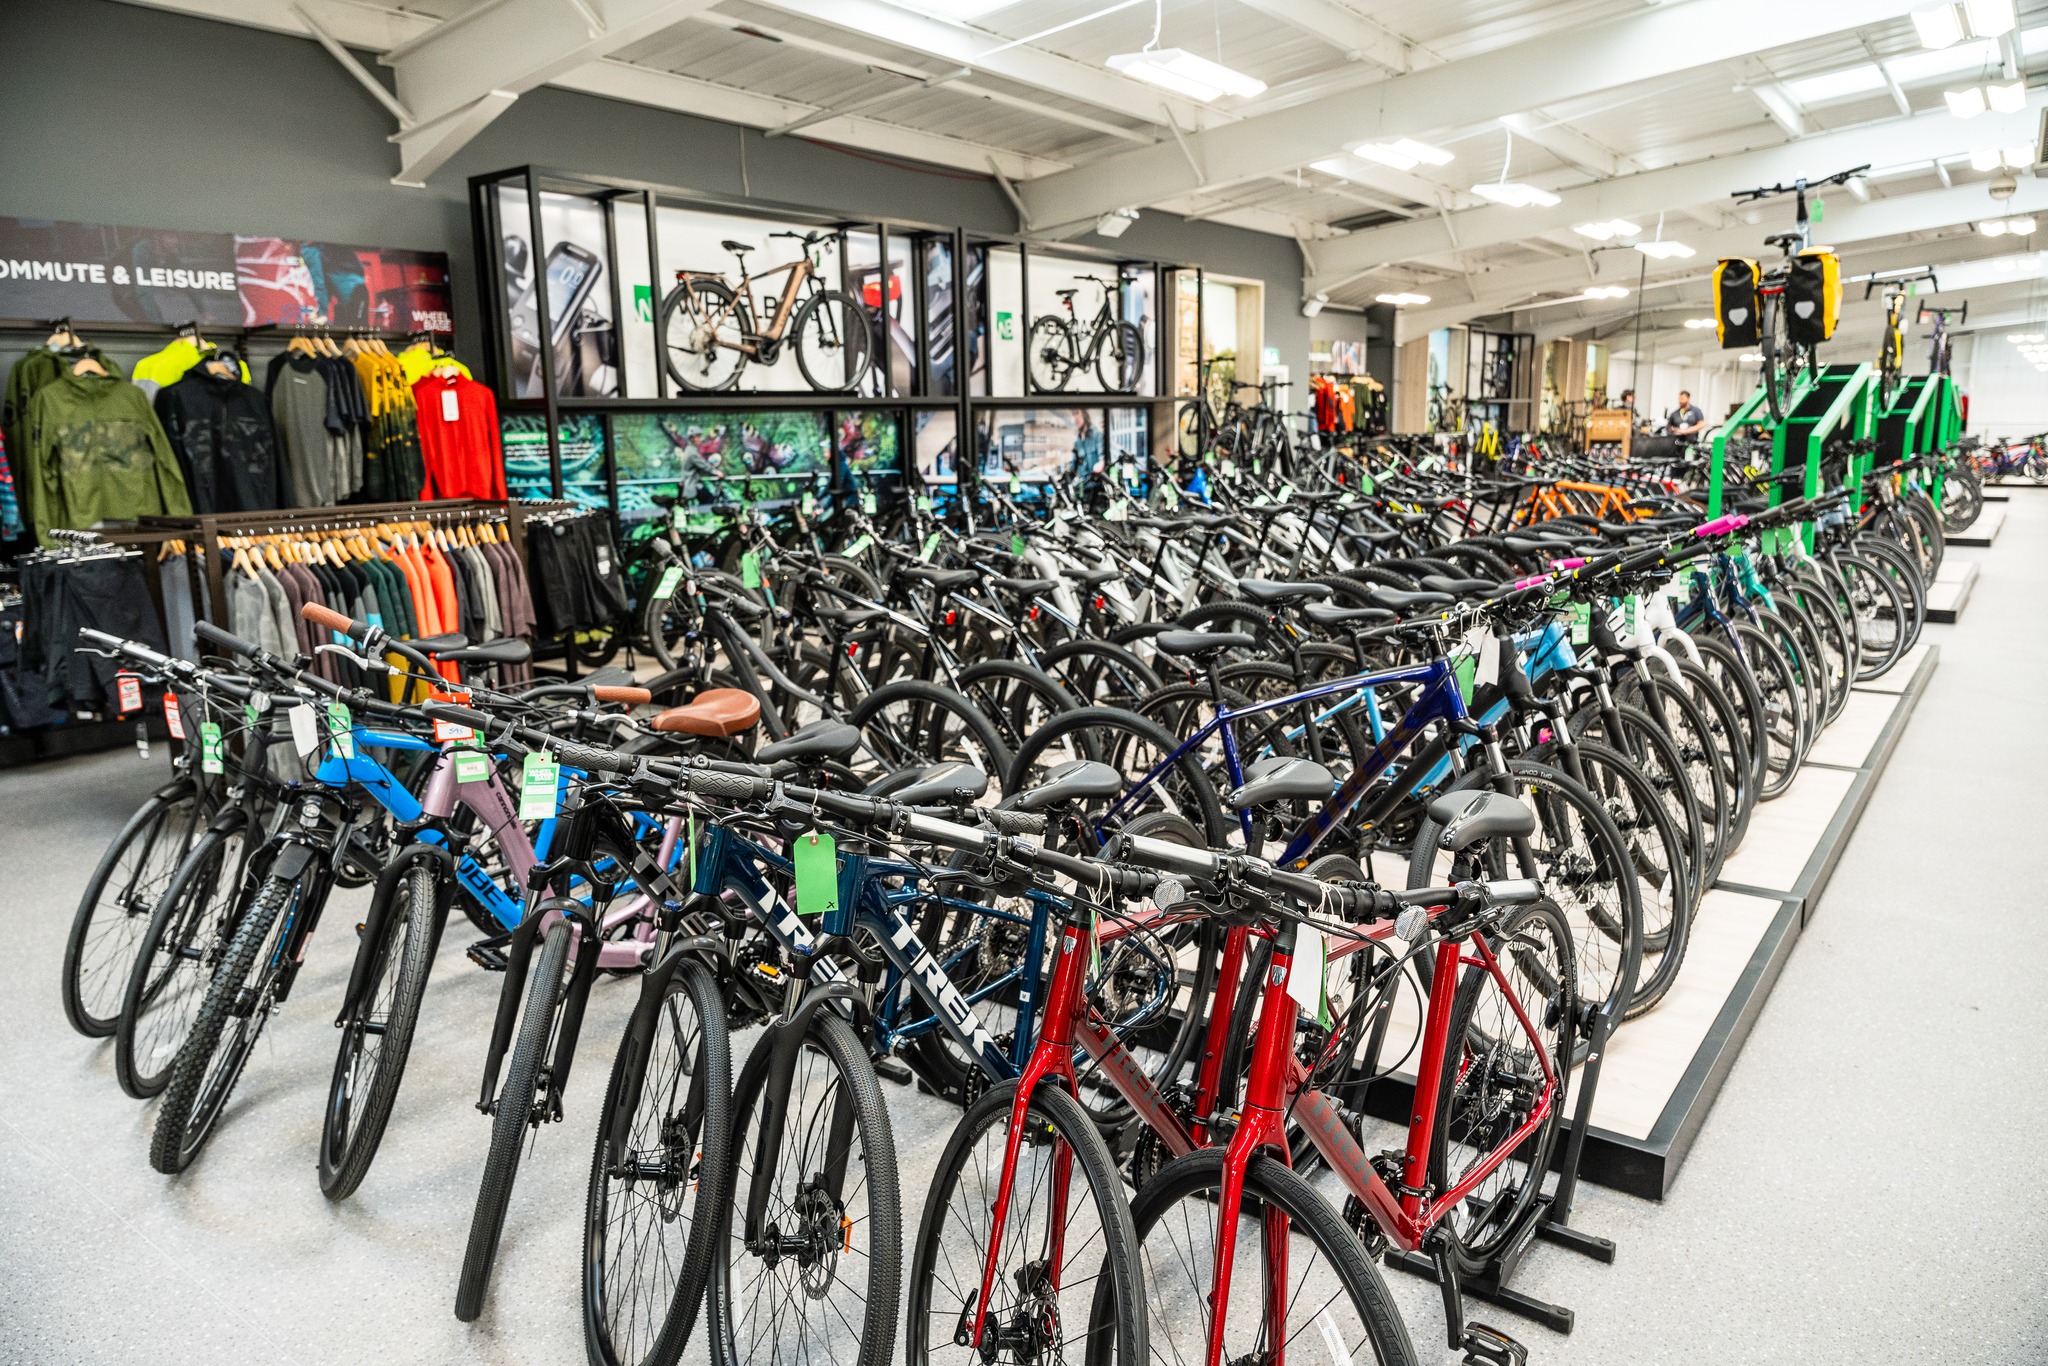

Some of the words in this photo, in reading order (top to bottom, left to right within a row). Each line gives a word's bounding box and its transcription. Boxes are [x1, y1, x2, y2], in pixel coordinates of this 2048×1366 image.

[112, 265, 131, 285] &
[136, 266, 236, 291] LEISURE
[411, 310, 448, 322] WHEEL
[423, 319, 453, 332] BASE
[528, 768, 552, 777] WHEEL
[890, 909, 995, 1057] TREK
[1100, 1032, 1167, 1115] TREK
[974, 1107, 1008, 1132] BONTRAGER
[1311, 1096, 1377, 1188] TREK
[595, 1148, 609, 1208] BONTRAGER
[717, 1292, 730, 1359] BONTRAGER
